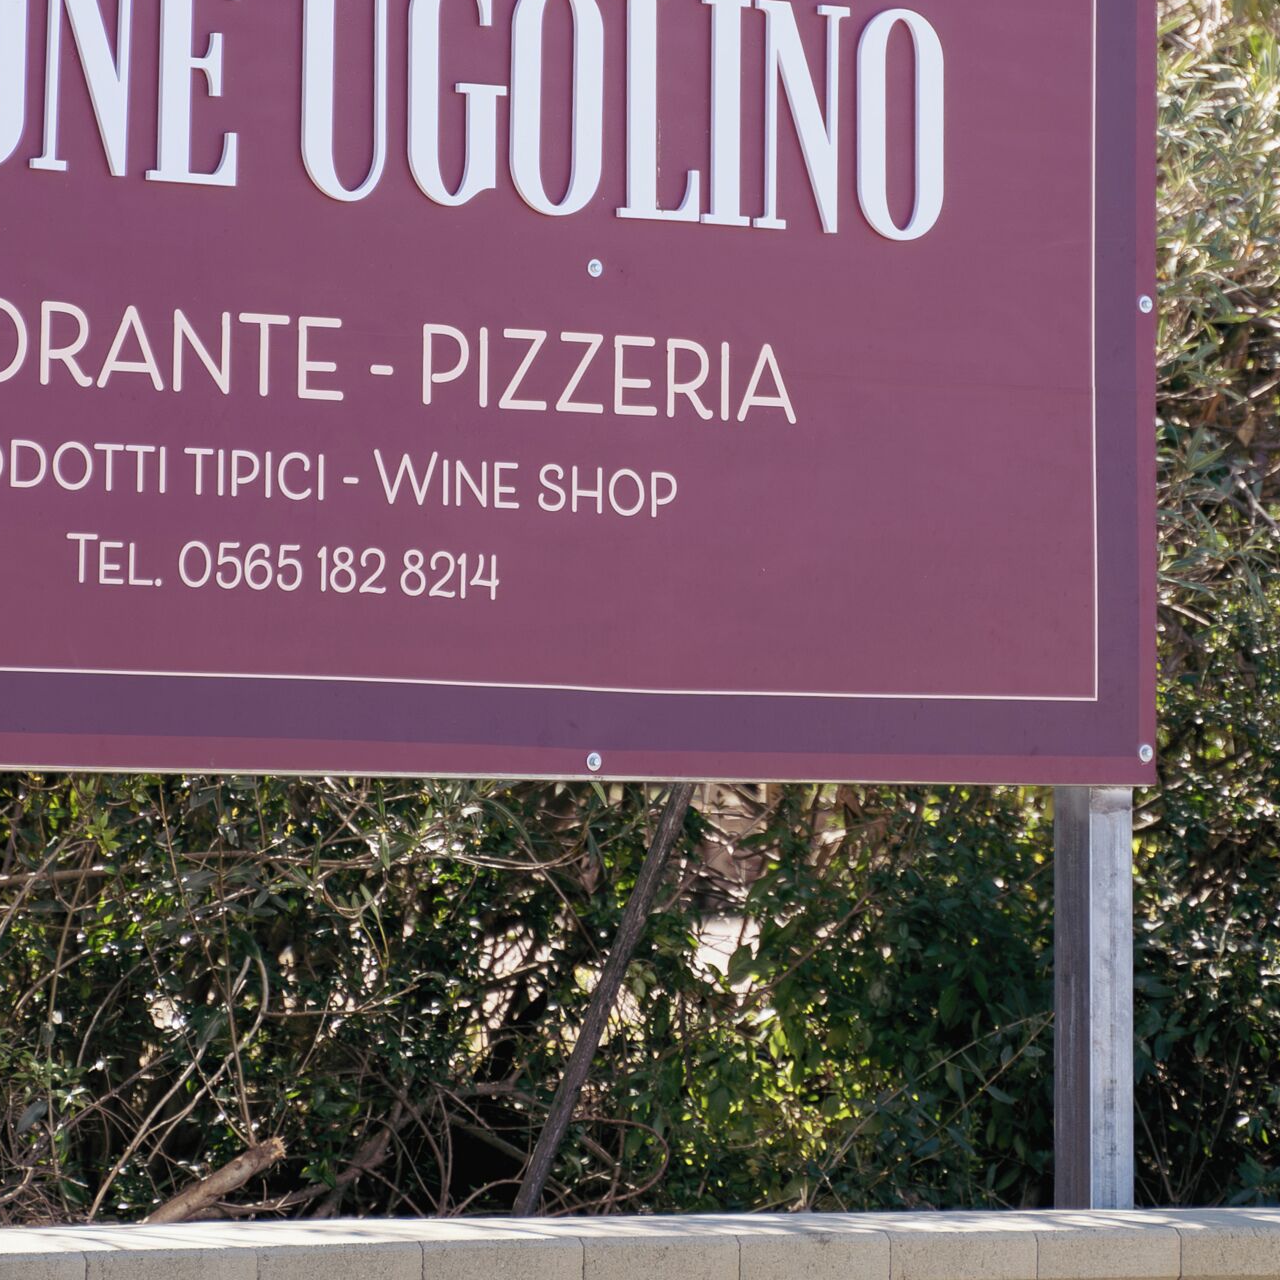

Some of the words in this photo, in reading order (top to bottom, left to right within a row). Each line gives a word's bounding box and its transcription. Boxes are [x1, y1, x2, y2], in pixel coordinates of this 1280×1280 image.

[422, 323, 798, 425] PIZZERIA
[178, 540, 303, 592] 0565
[317, 546, 387, 595] 182
[400, 549, 501, 601] 8214
